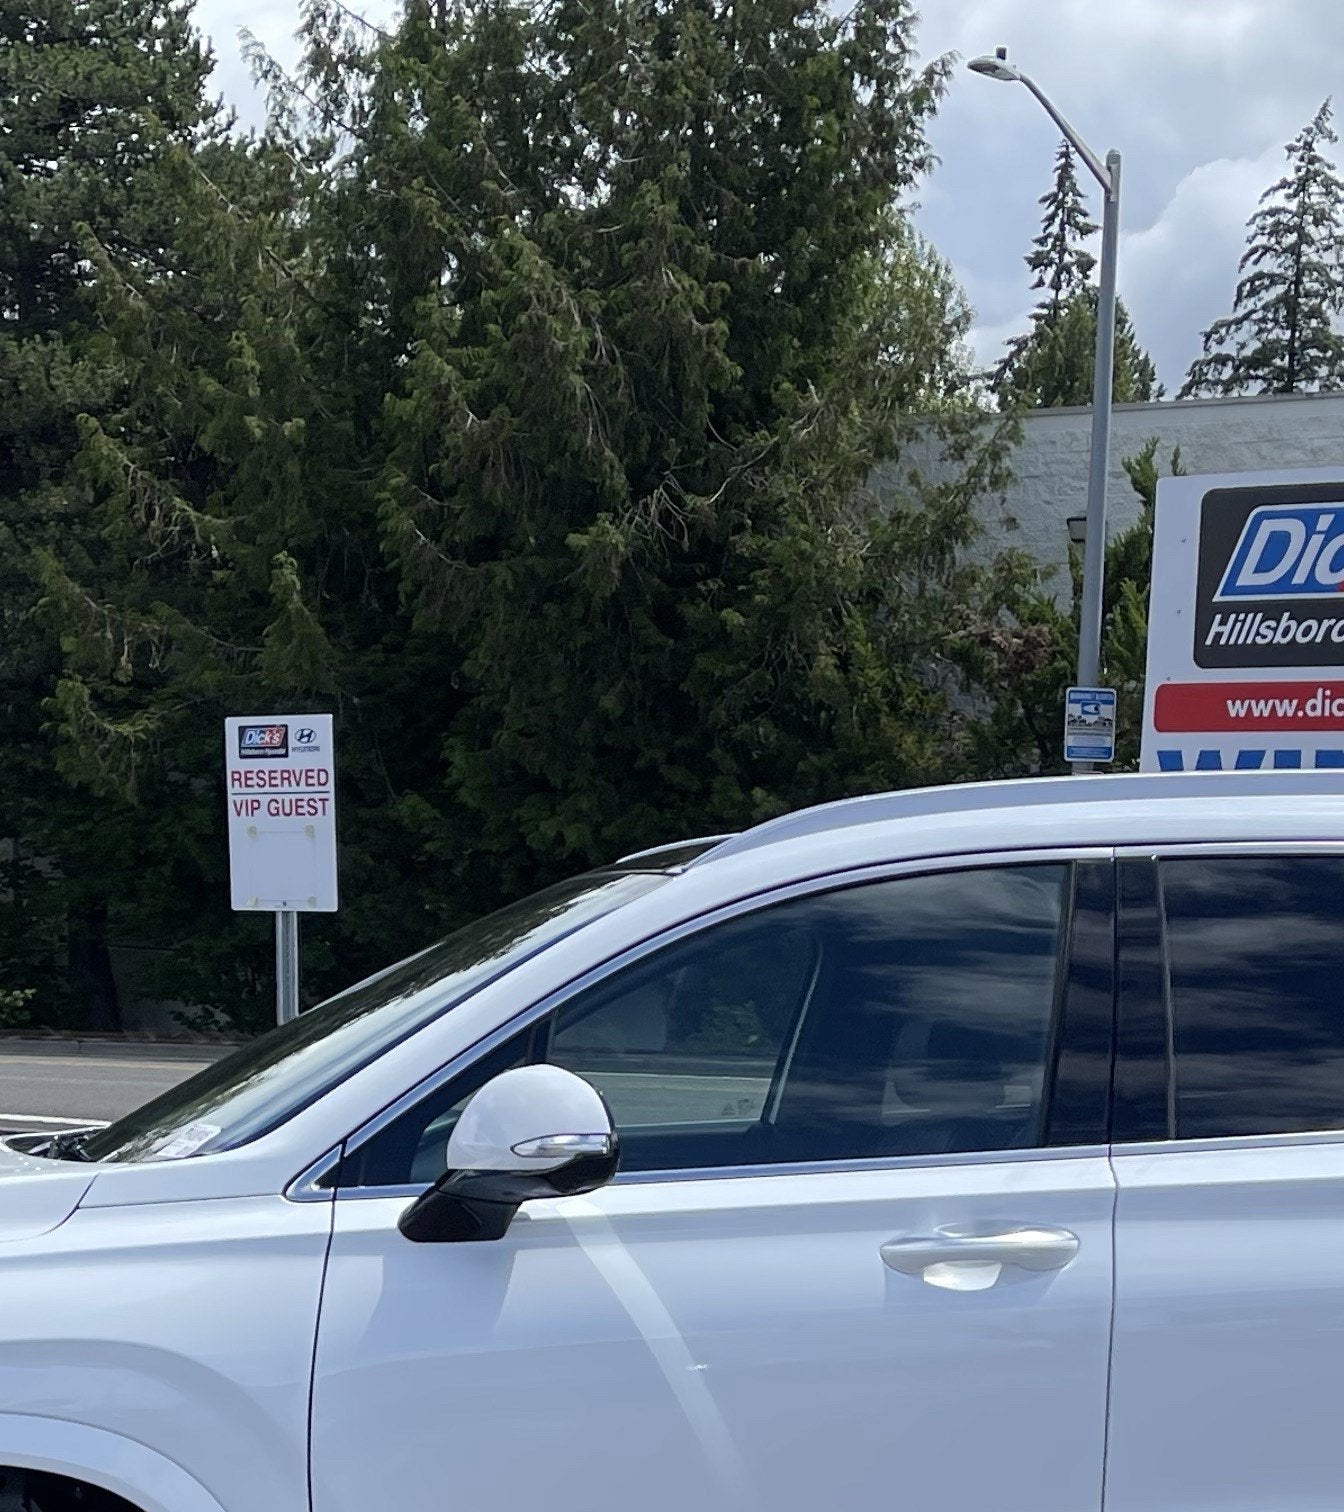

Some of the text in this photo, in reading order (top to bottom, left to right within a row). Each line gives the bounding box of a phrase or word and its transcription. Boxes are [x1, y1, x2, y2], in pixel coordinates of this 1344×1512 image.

[231, 768, 330, 789] RESERVED
[233, 798, 330, 817] VIP GUEST
